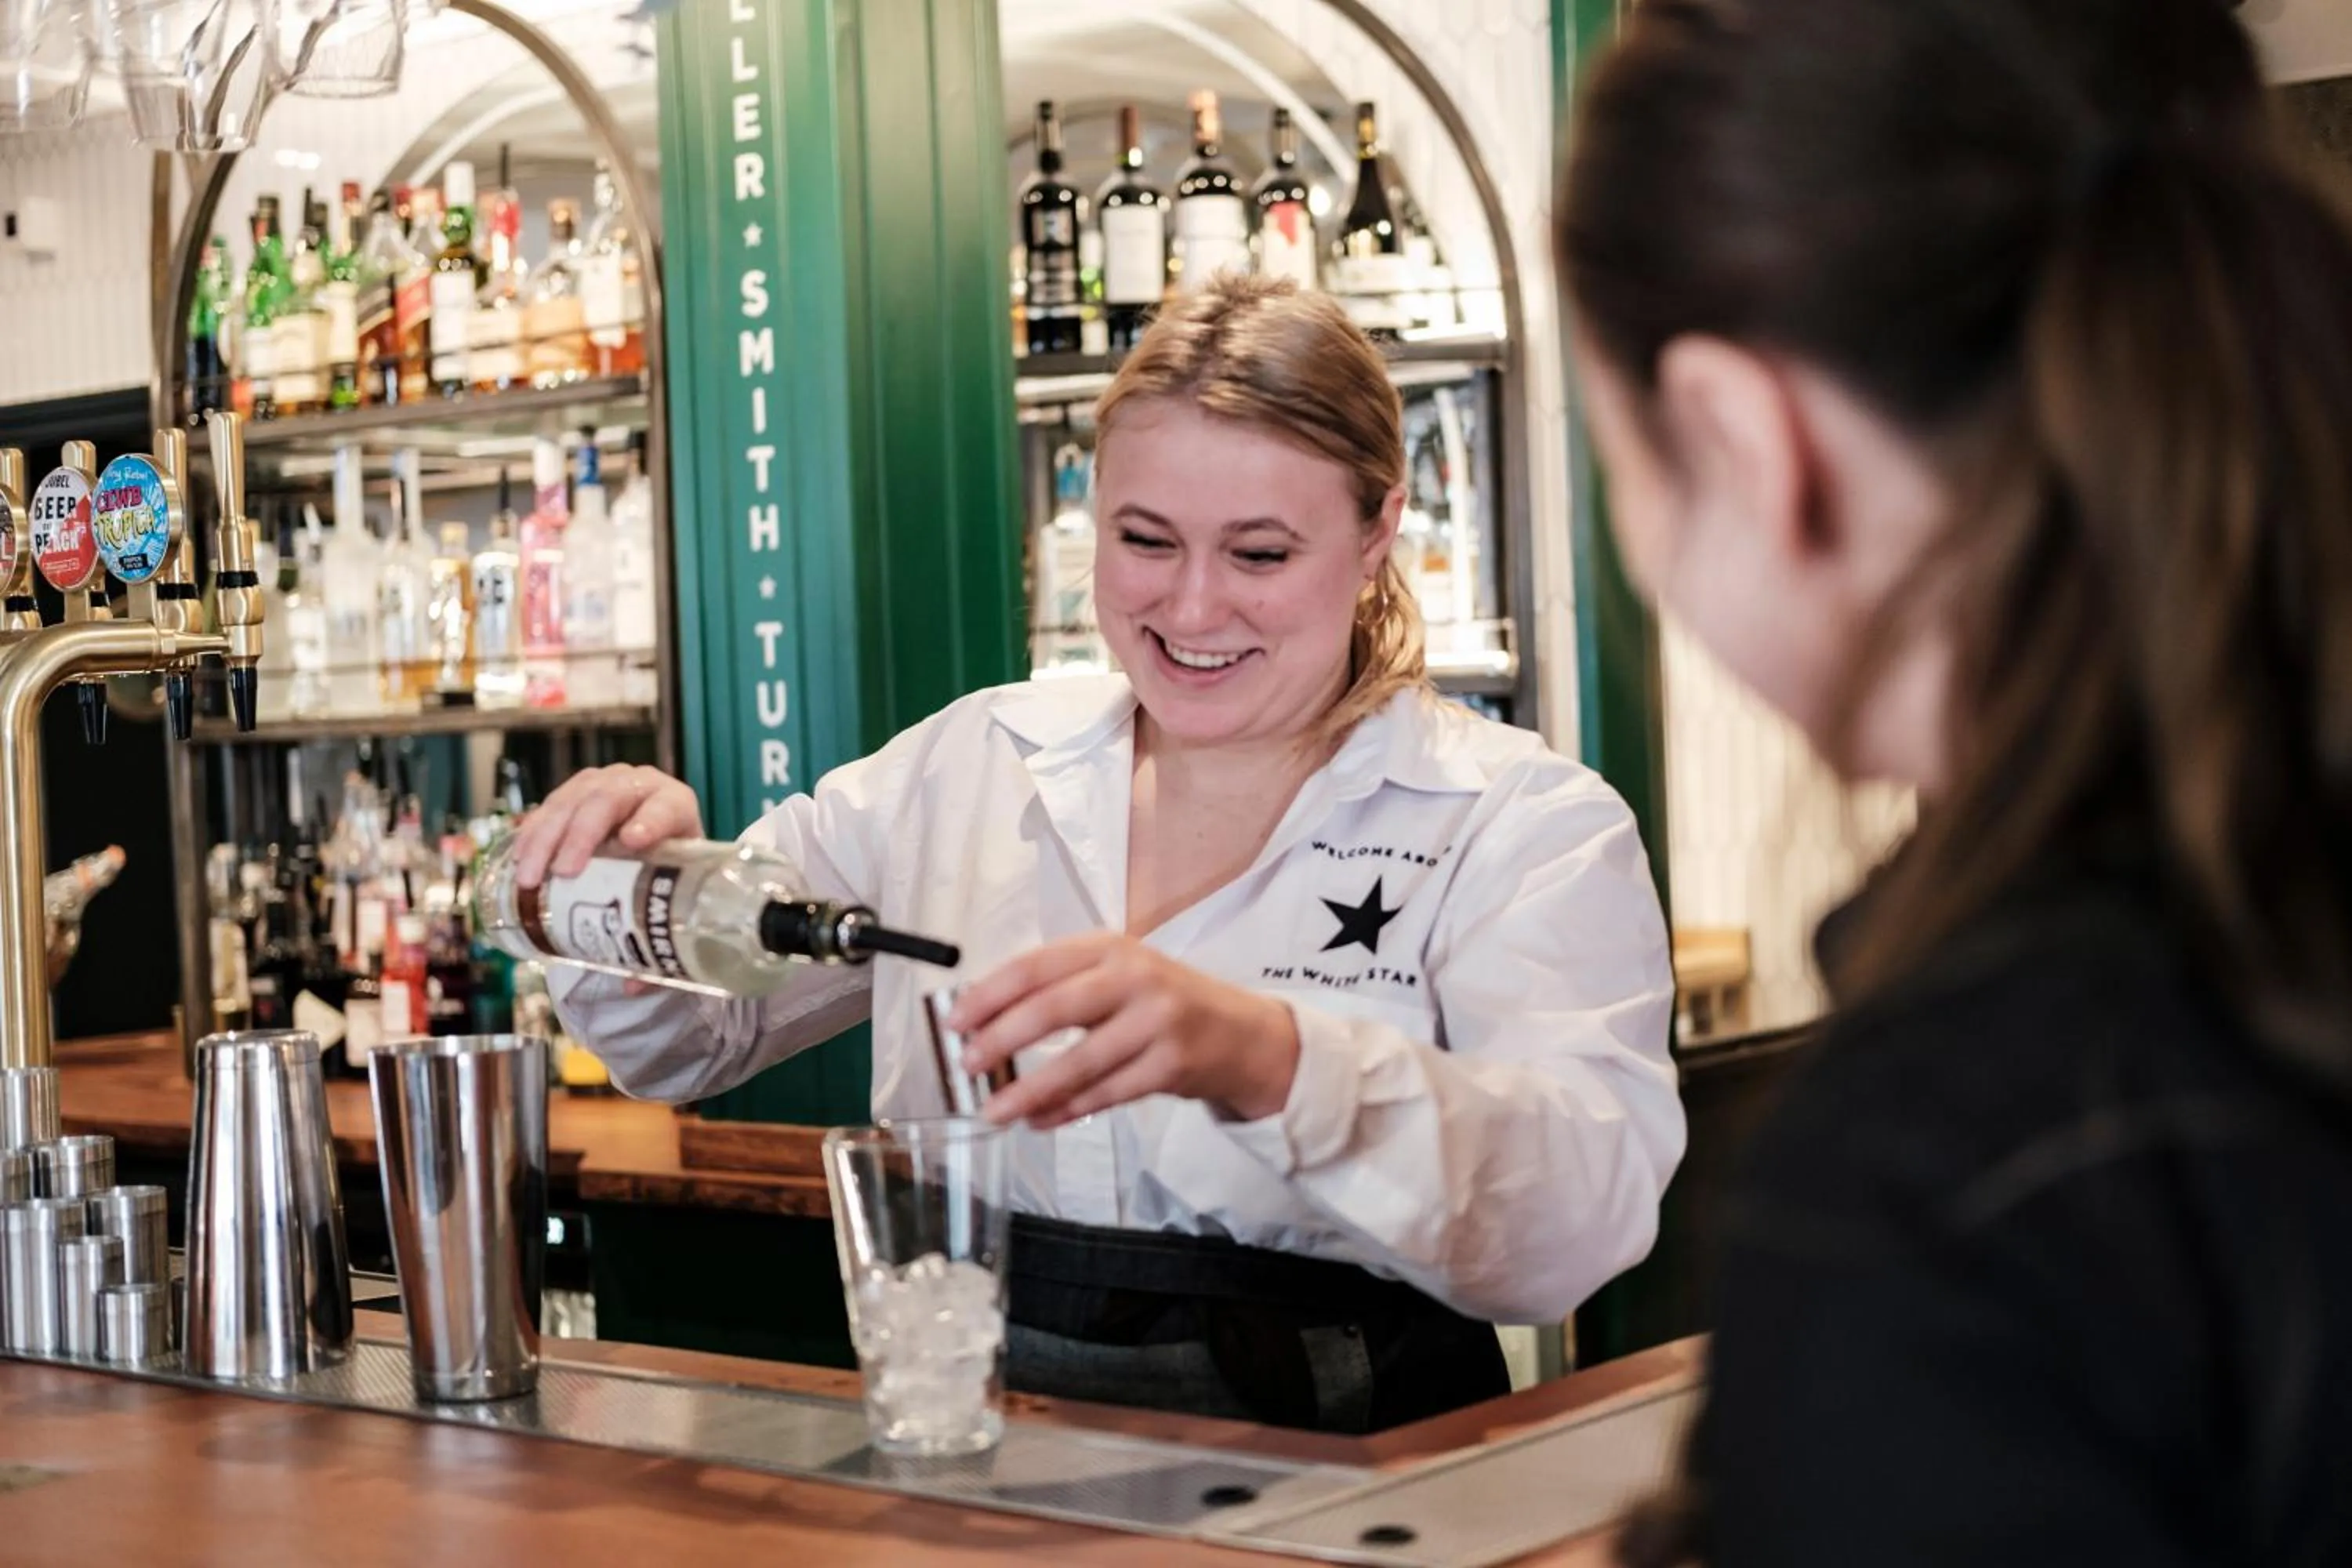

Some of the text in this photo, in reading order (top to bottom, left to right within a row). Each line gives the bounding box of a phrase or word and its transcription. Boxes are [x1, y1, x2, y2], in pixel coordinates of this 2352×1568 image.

[739, 269, 779, 552] SMITH
[45, 474, 71, 488] JUBEL
[34, 496, 78, 520] BEER
[754, 621, 790, 813] TUR
[1312, 841, 1393, 860] WELCOME
[1261, 967, 1294, 978] THE
[1367, 967, 1417, 987] STAR
